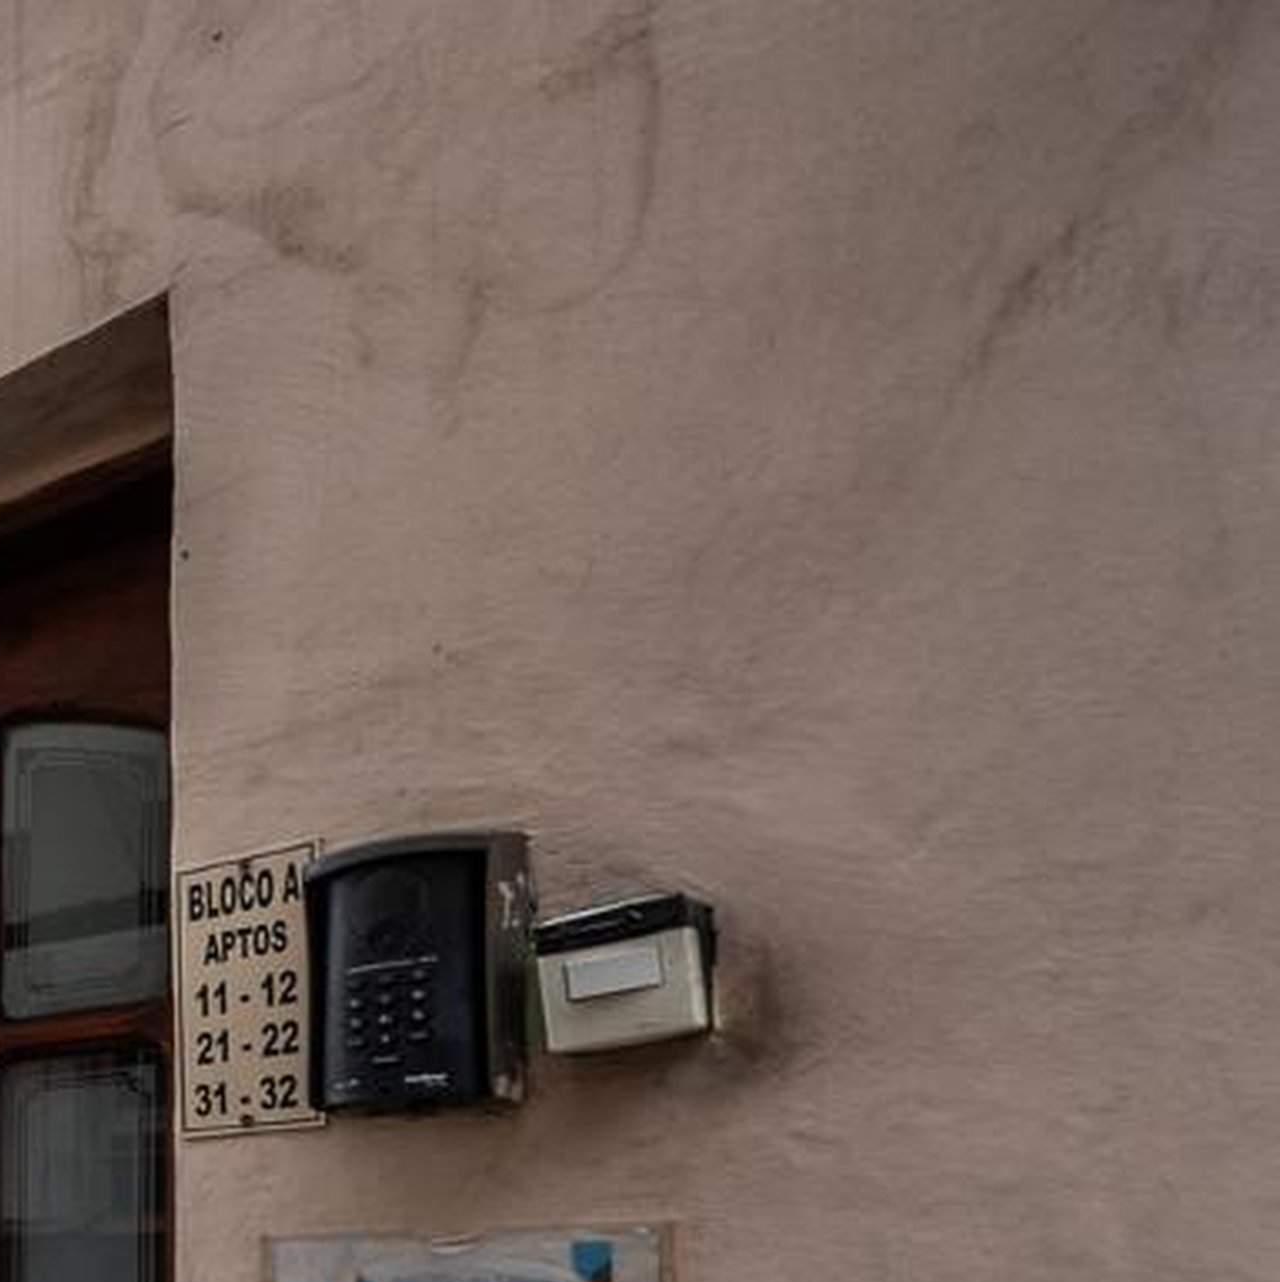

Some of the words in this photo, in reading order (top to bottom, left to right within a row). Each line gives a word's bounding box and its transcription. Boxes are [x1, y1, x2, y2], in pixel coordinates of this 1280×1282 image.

[190, 868, 273, 921] BLOCO
[283, 863, 299, 903] A
[203, 920, 287, 965] APTOS
[196, 980, 226, 1017] 11
[261, 970, 297, 1007] 12
[197, 1029, 229, 1066] 21
[262, 1020, 299, 1057] 22
[195, 1081, 227, 1116] 31
[260, 1074, 298, 1110] 32
